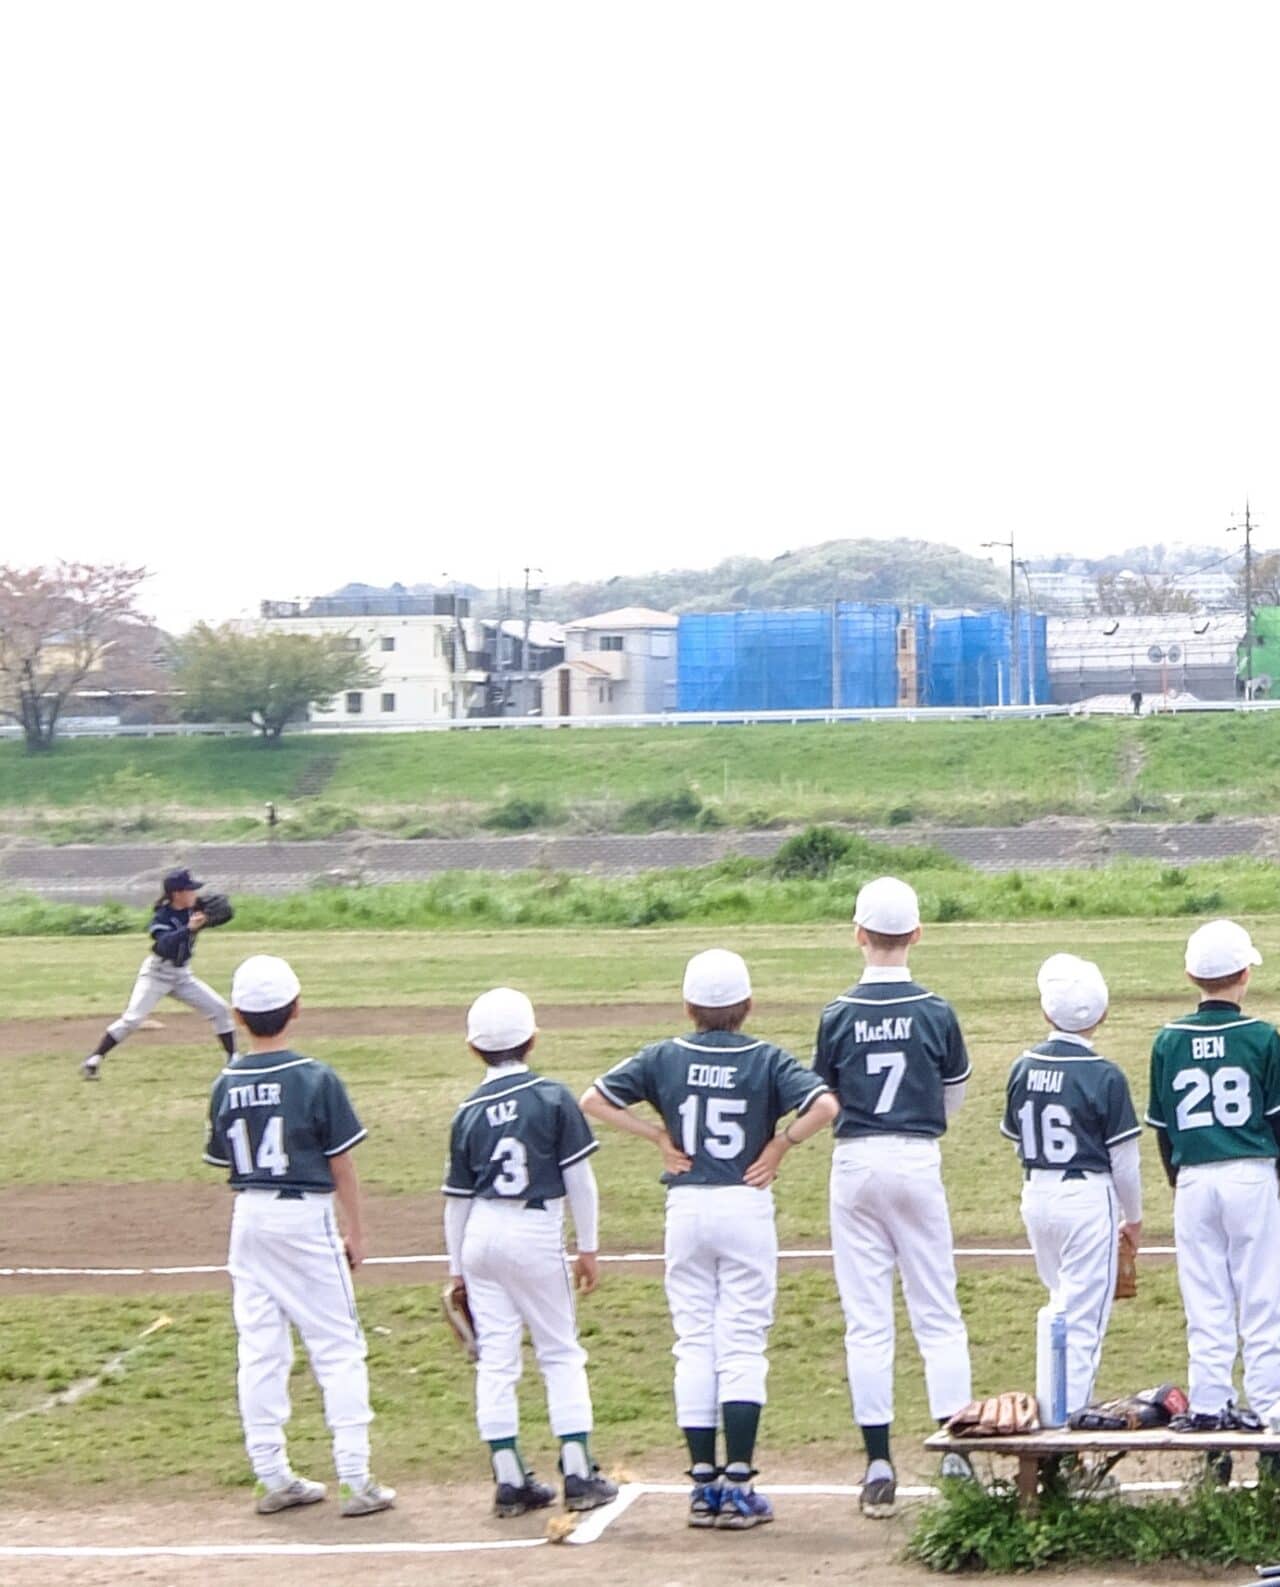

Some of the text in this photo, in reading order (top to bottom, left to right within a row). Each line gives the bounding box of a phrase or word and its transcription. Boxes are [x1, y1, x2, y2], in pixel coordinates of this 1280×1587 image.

[686, 1063, 738, 1090] EDDIE
[1192, 1036, 1224, 1060] BEN
[228, 1083, 282, 1110] TYLER
[865, 1052, 907, 1115] 7
[1026, 1069, 1064, 1094] MIHAI
[1172, 1066, 1251, 1131] 28
[486, 1100, 518, 1128] KAZ
[678, 1094, 748, 1160] 15
[1017, 1100, 1078, 1164] 16
[226, 1116, 289, 1176] 14
[490, 1137, 528, 1196] 3
